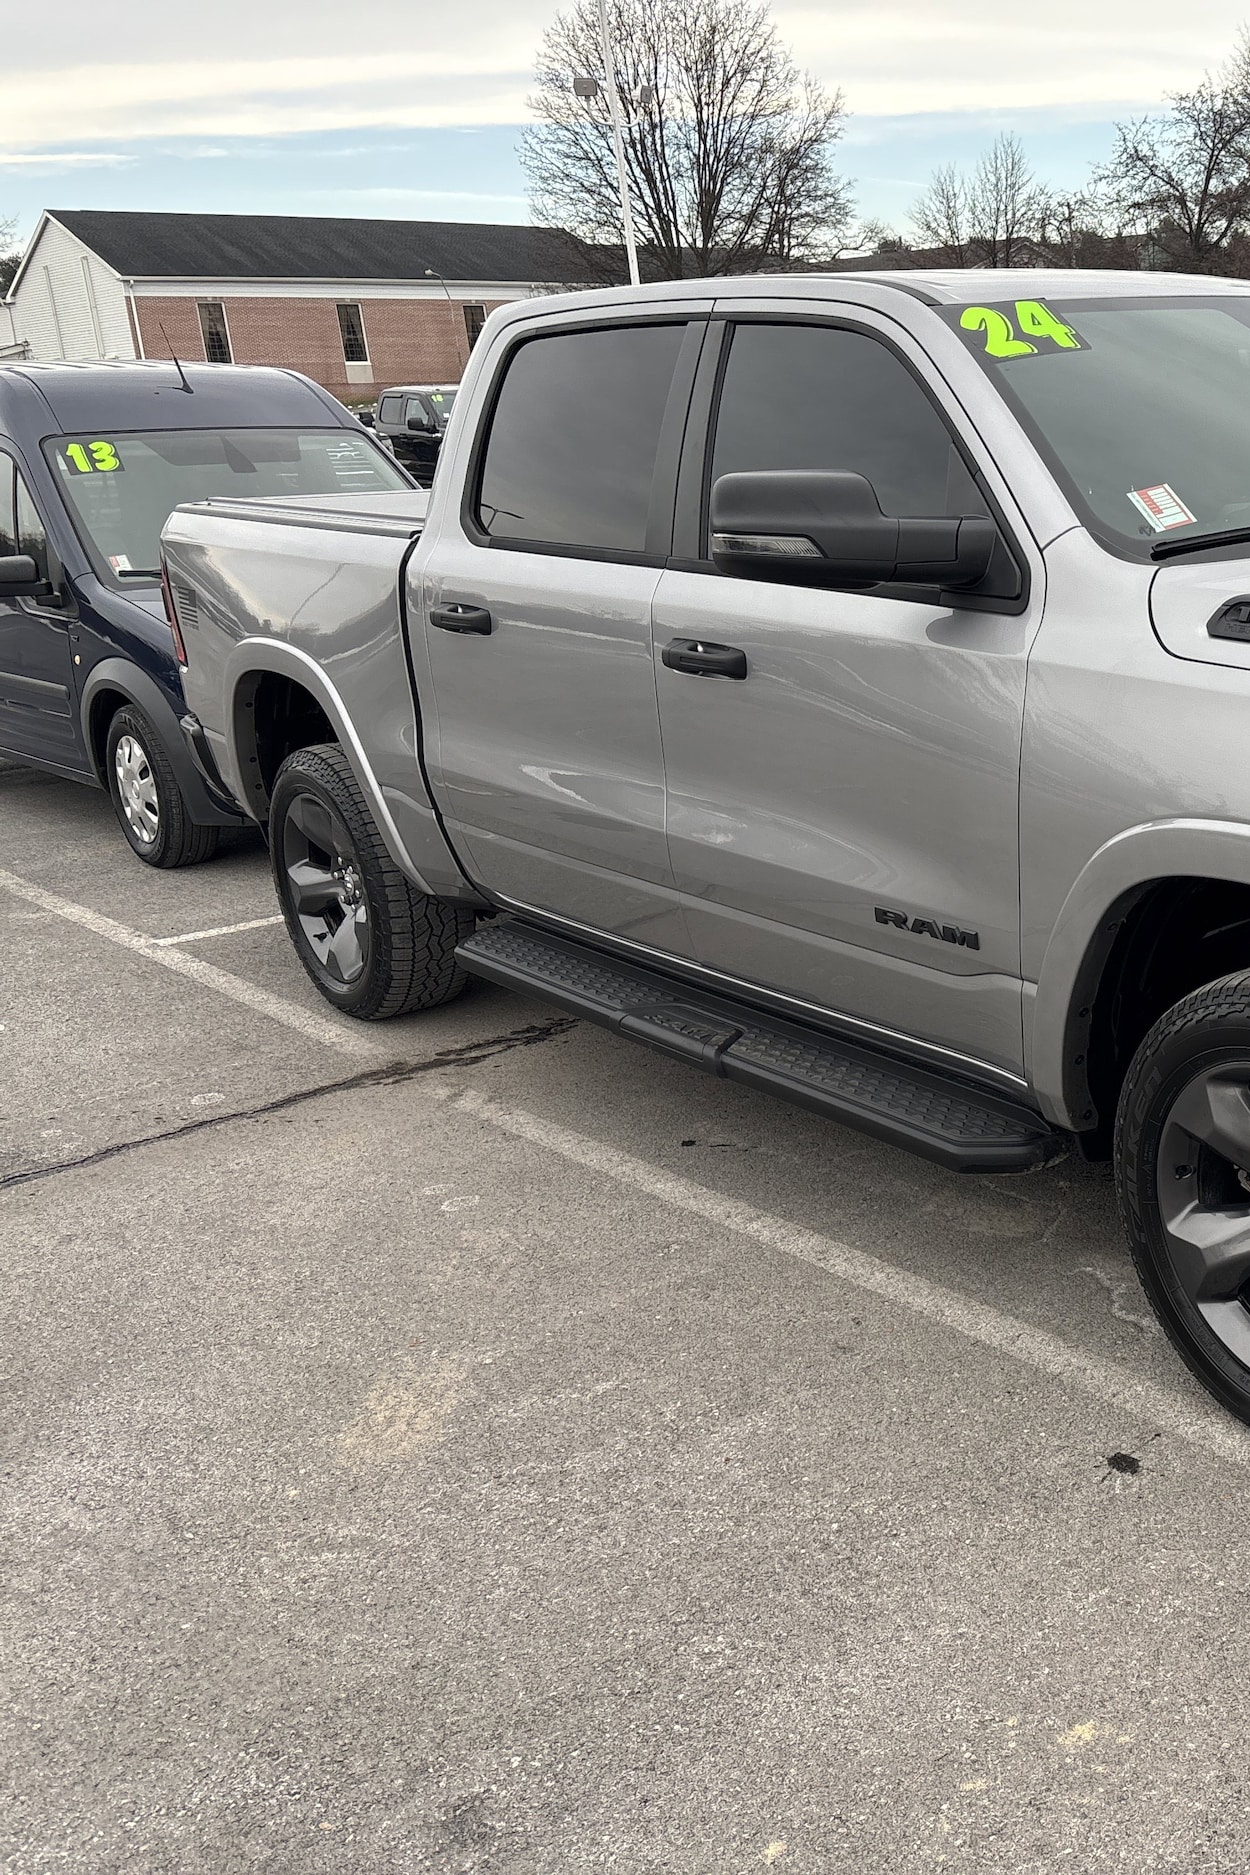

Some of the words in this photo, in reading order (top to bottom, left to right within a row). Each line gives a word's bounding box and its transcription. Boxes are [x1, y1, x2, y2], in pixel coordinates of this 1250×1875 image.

[960, 300, 1082, 358] 24
[65, 441, 120, 473] 13
[874, 905, 981, 951] RAM
